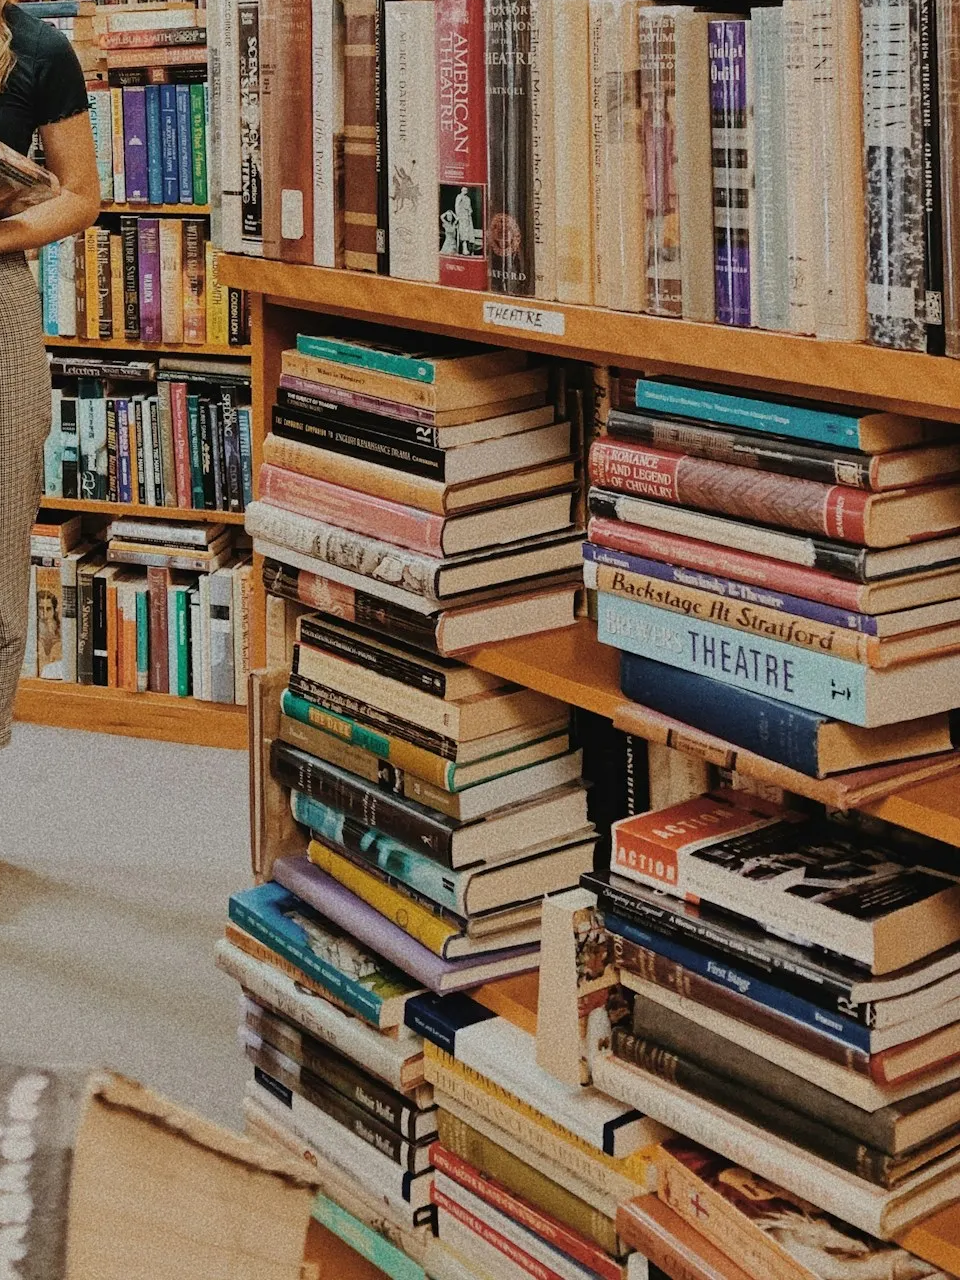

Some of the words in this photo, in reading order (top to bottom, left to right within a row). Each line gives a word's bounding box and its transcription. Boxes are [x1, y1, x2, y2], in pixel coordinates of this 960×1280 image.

[107, 34, 141, 45] WILBUR
[143, 32, 171, 42] SMITH
[313, 44, 323, 66] The
[119, 76, 140, 85] SMITH
[441, 31, 454, 132] THEATRE
[453, 31, 469, 154] AMERICAN
[921, 62, 931, 126] THEATRE
[313, 110, 324, 121] of
[314, 126, 324, 142] the
[314, 149, 324, 190] People
[123, 229, 135, 263] WILBUR
[186, 224, 198, 258] WILBUR
[45, 244, 58, 276] SELFISH
[97, 247, 107, 275] Killers
[124, 265, 136, 290] SMITH
[143, 274, 153, 304] WARLOCK
[46, 282, 60, 324] PERVERSE
[126, 303, 138, 327] QUEST
[229, 290, 239, 318] GOLDEN
[486, 306, 543, 327] THEATRE
[230, 318, 240, 334] LION
[221, 394, 232, 437] SPEDDING
[610, 450, 659, 469] ROMANCE
[610, 464, 631, 478] AND
[633, 467, 671, 485] LEGEND
[611, 477, 625, 488] OF
[626, 481, 674, 499] CHIVALRY
[237, 577, 248, 613] Everybody
[239, 614, 248, 629] Who
[611, 571, 703, 614] Backstage
[710, 600, 733, 621] At
[735, 606, 836, 650] Stratford
[239, 630, 249, 643] Was
[240, 644, 250, 673] Anybody
[688, 631, 794, 694] THEATRE
[651, 808, 735, 840] ACTION
[616, 847, 677, 880] ACTION
